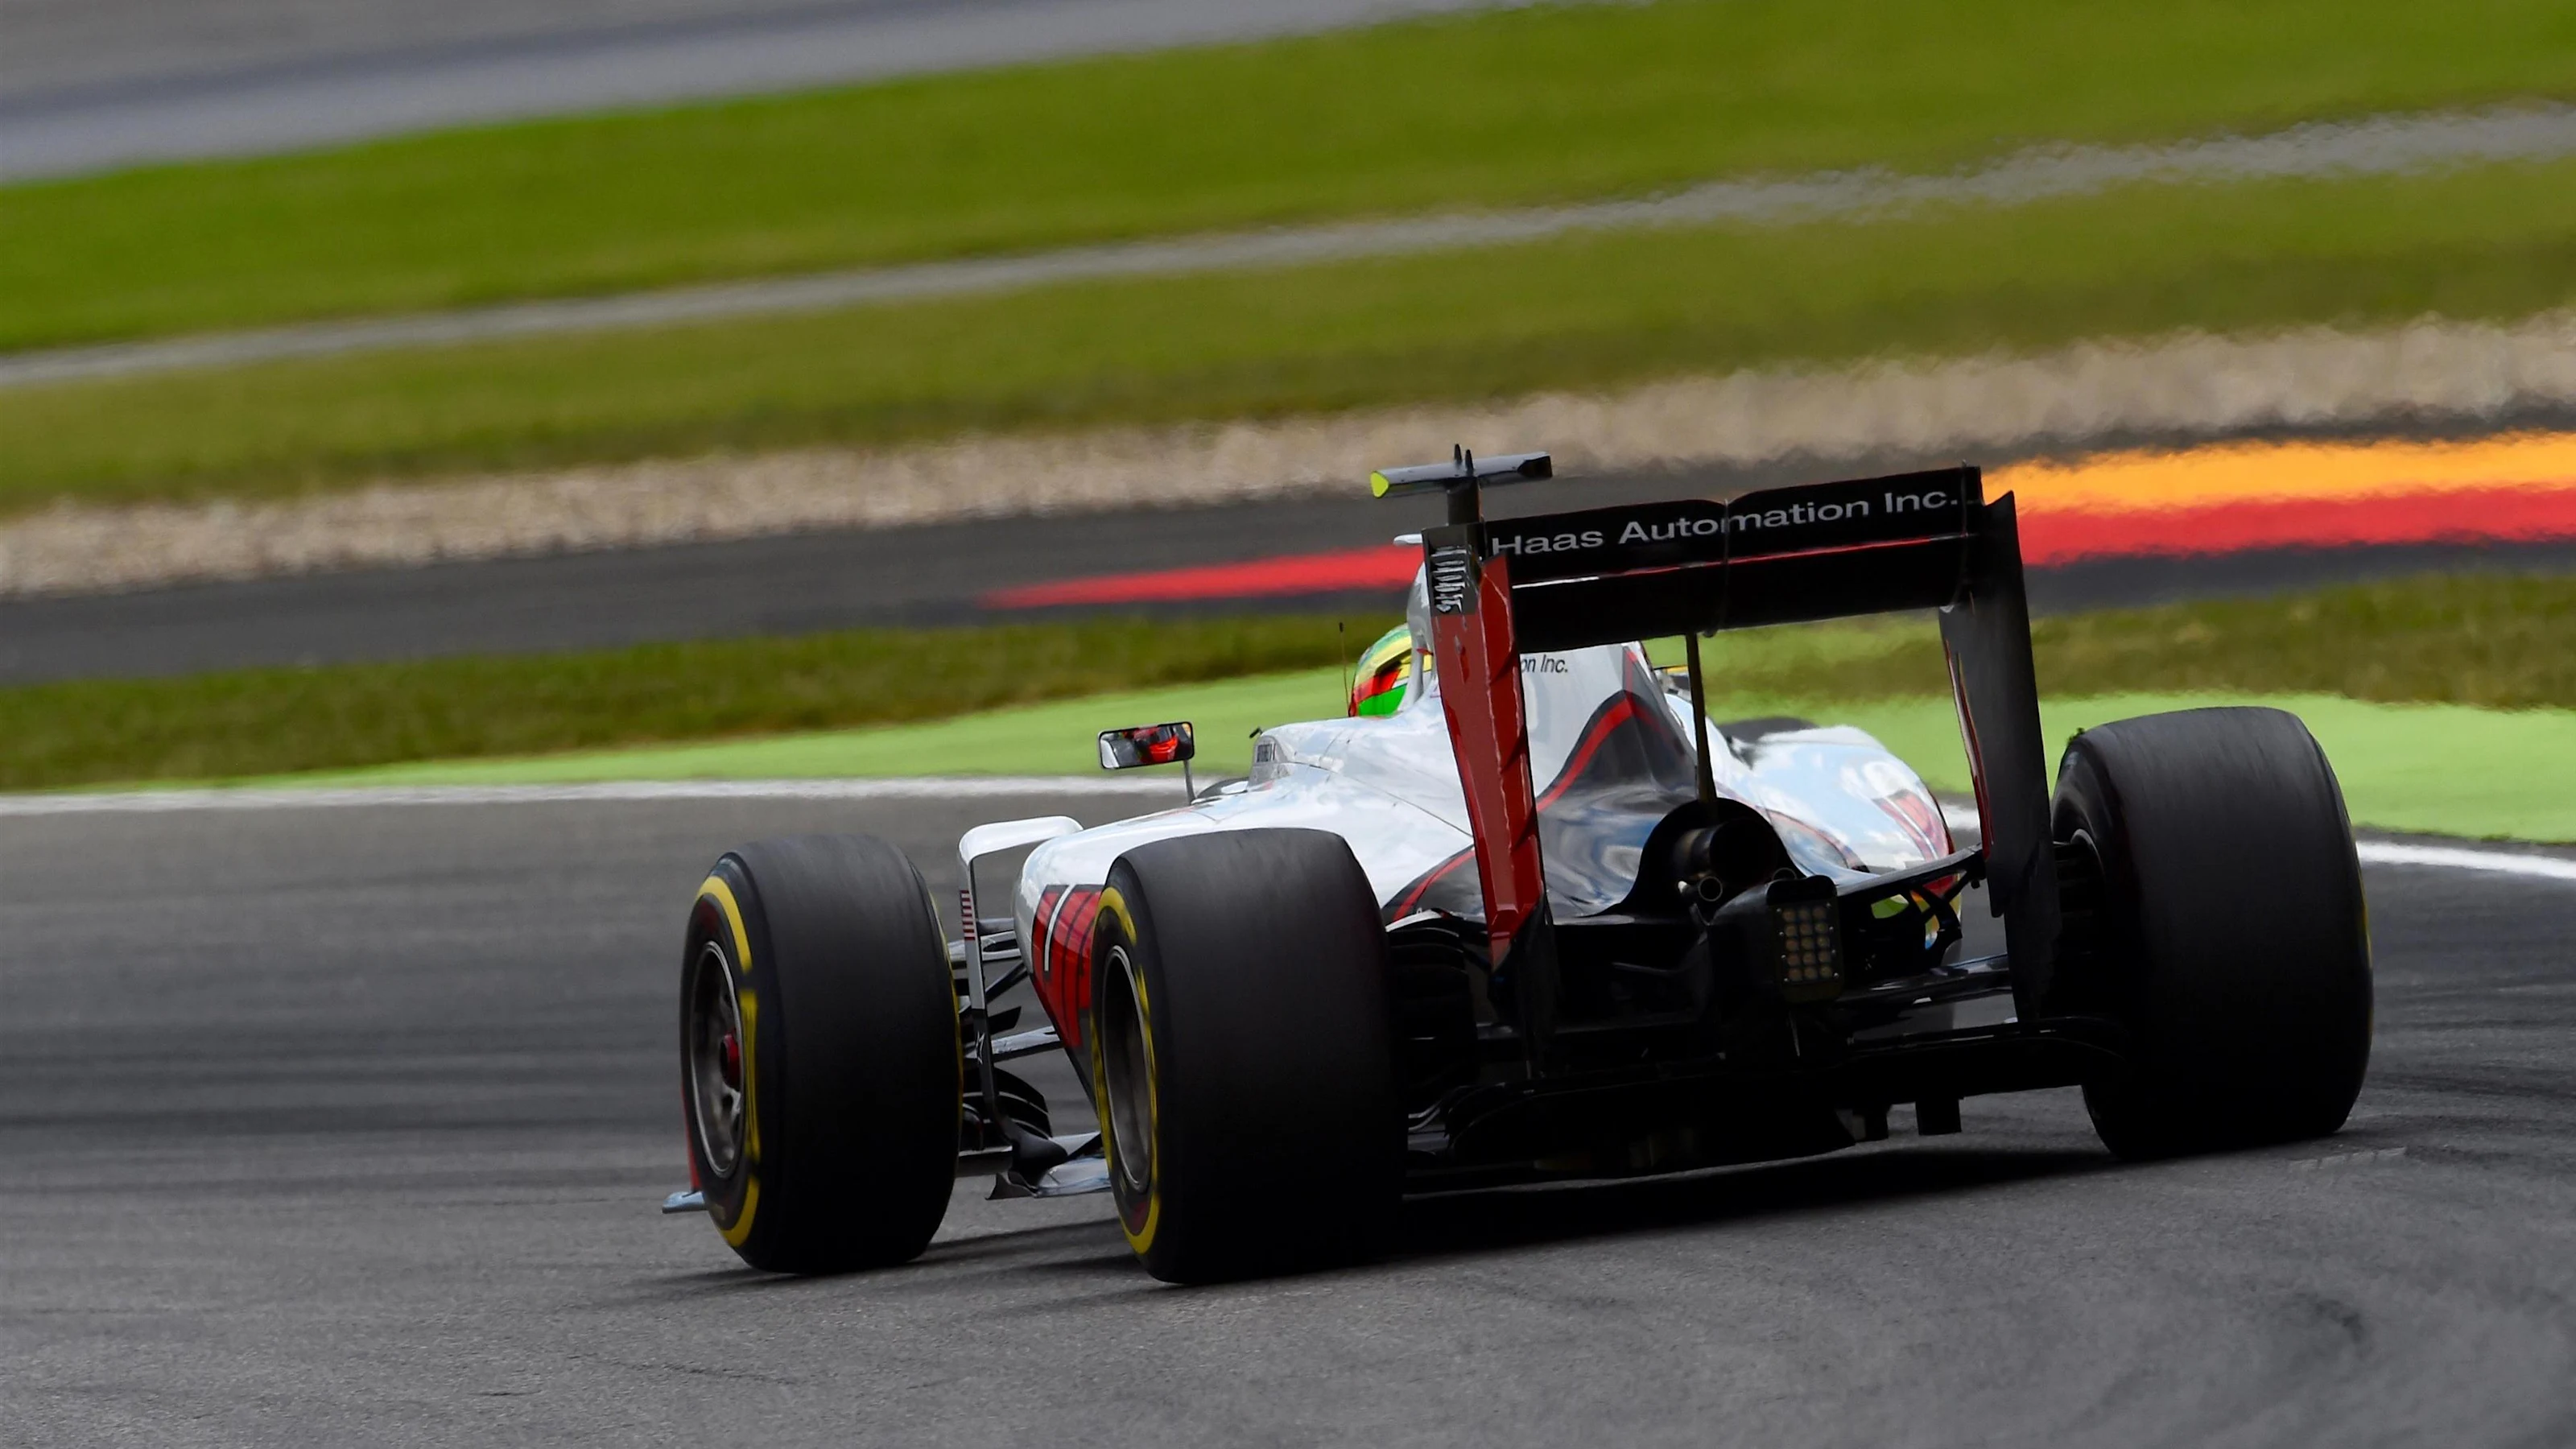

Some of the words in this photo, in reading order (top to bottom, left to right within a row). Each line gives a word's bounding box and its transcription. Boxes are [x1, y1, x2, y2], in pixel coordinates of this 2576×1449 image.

[1492, 530, 1604, 555] Haas
[1618, 499, 1869, 544] Automation
[1885, 490, 1958, 514] Inc.
[1540, 654, 1568, 674] Inc.
